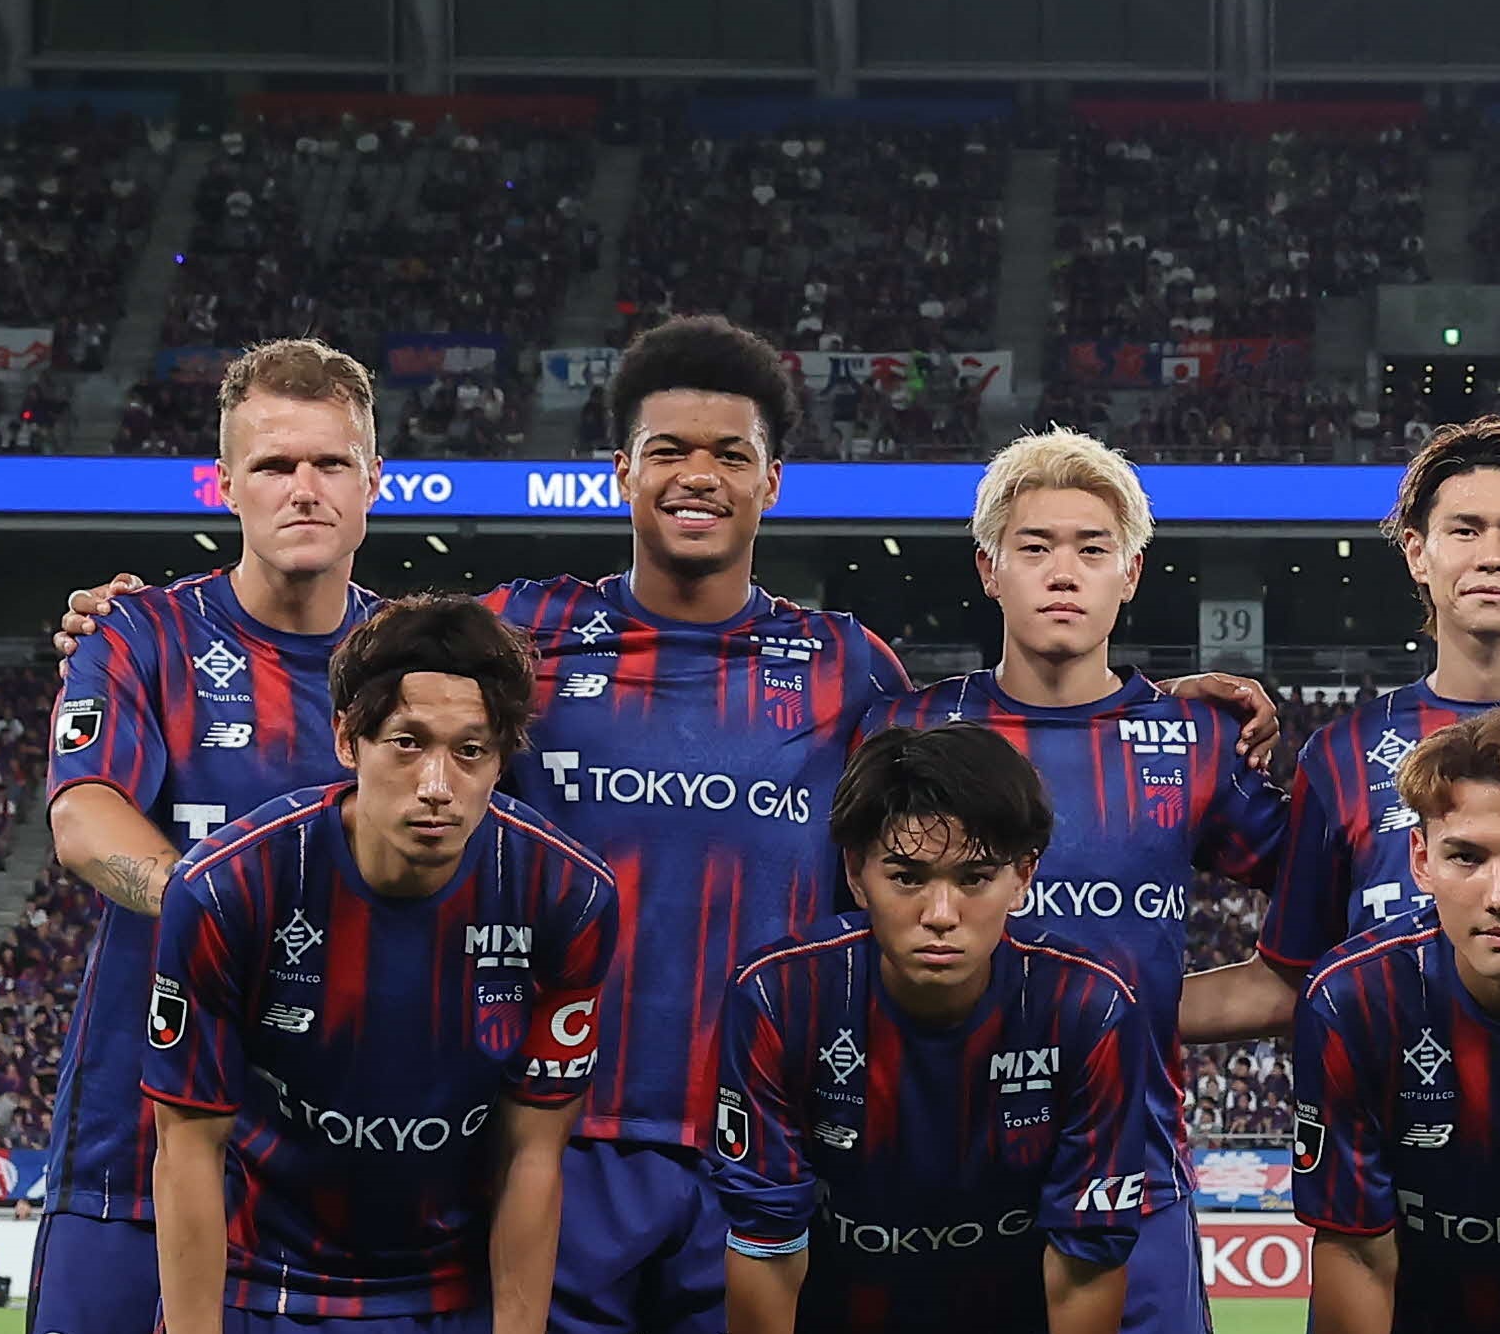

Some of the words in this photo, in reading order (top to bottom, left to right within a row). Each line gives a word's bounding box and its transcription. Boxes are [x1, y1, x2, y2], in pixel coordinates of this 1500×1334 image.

[1210, 608, 1252, 642] 39
[1118, 720, 1197, 744] MIXI
[588, 766, 736, 810] TOKYO
[748, 780, 810, 824] GAS
[1134, 883, 1186, 921] GAS
[464, 924, 533, 955] MIXI
[551, 998, 595, 1046] C
[990, 1046, 1059, 1081] MIXI
[300, 1098, 450, 1152] TOKYO
[834, 1212, 984, 1255] TOKYO
[1201, 1235, 1314, 1288] KO
